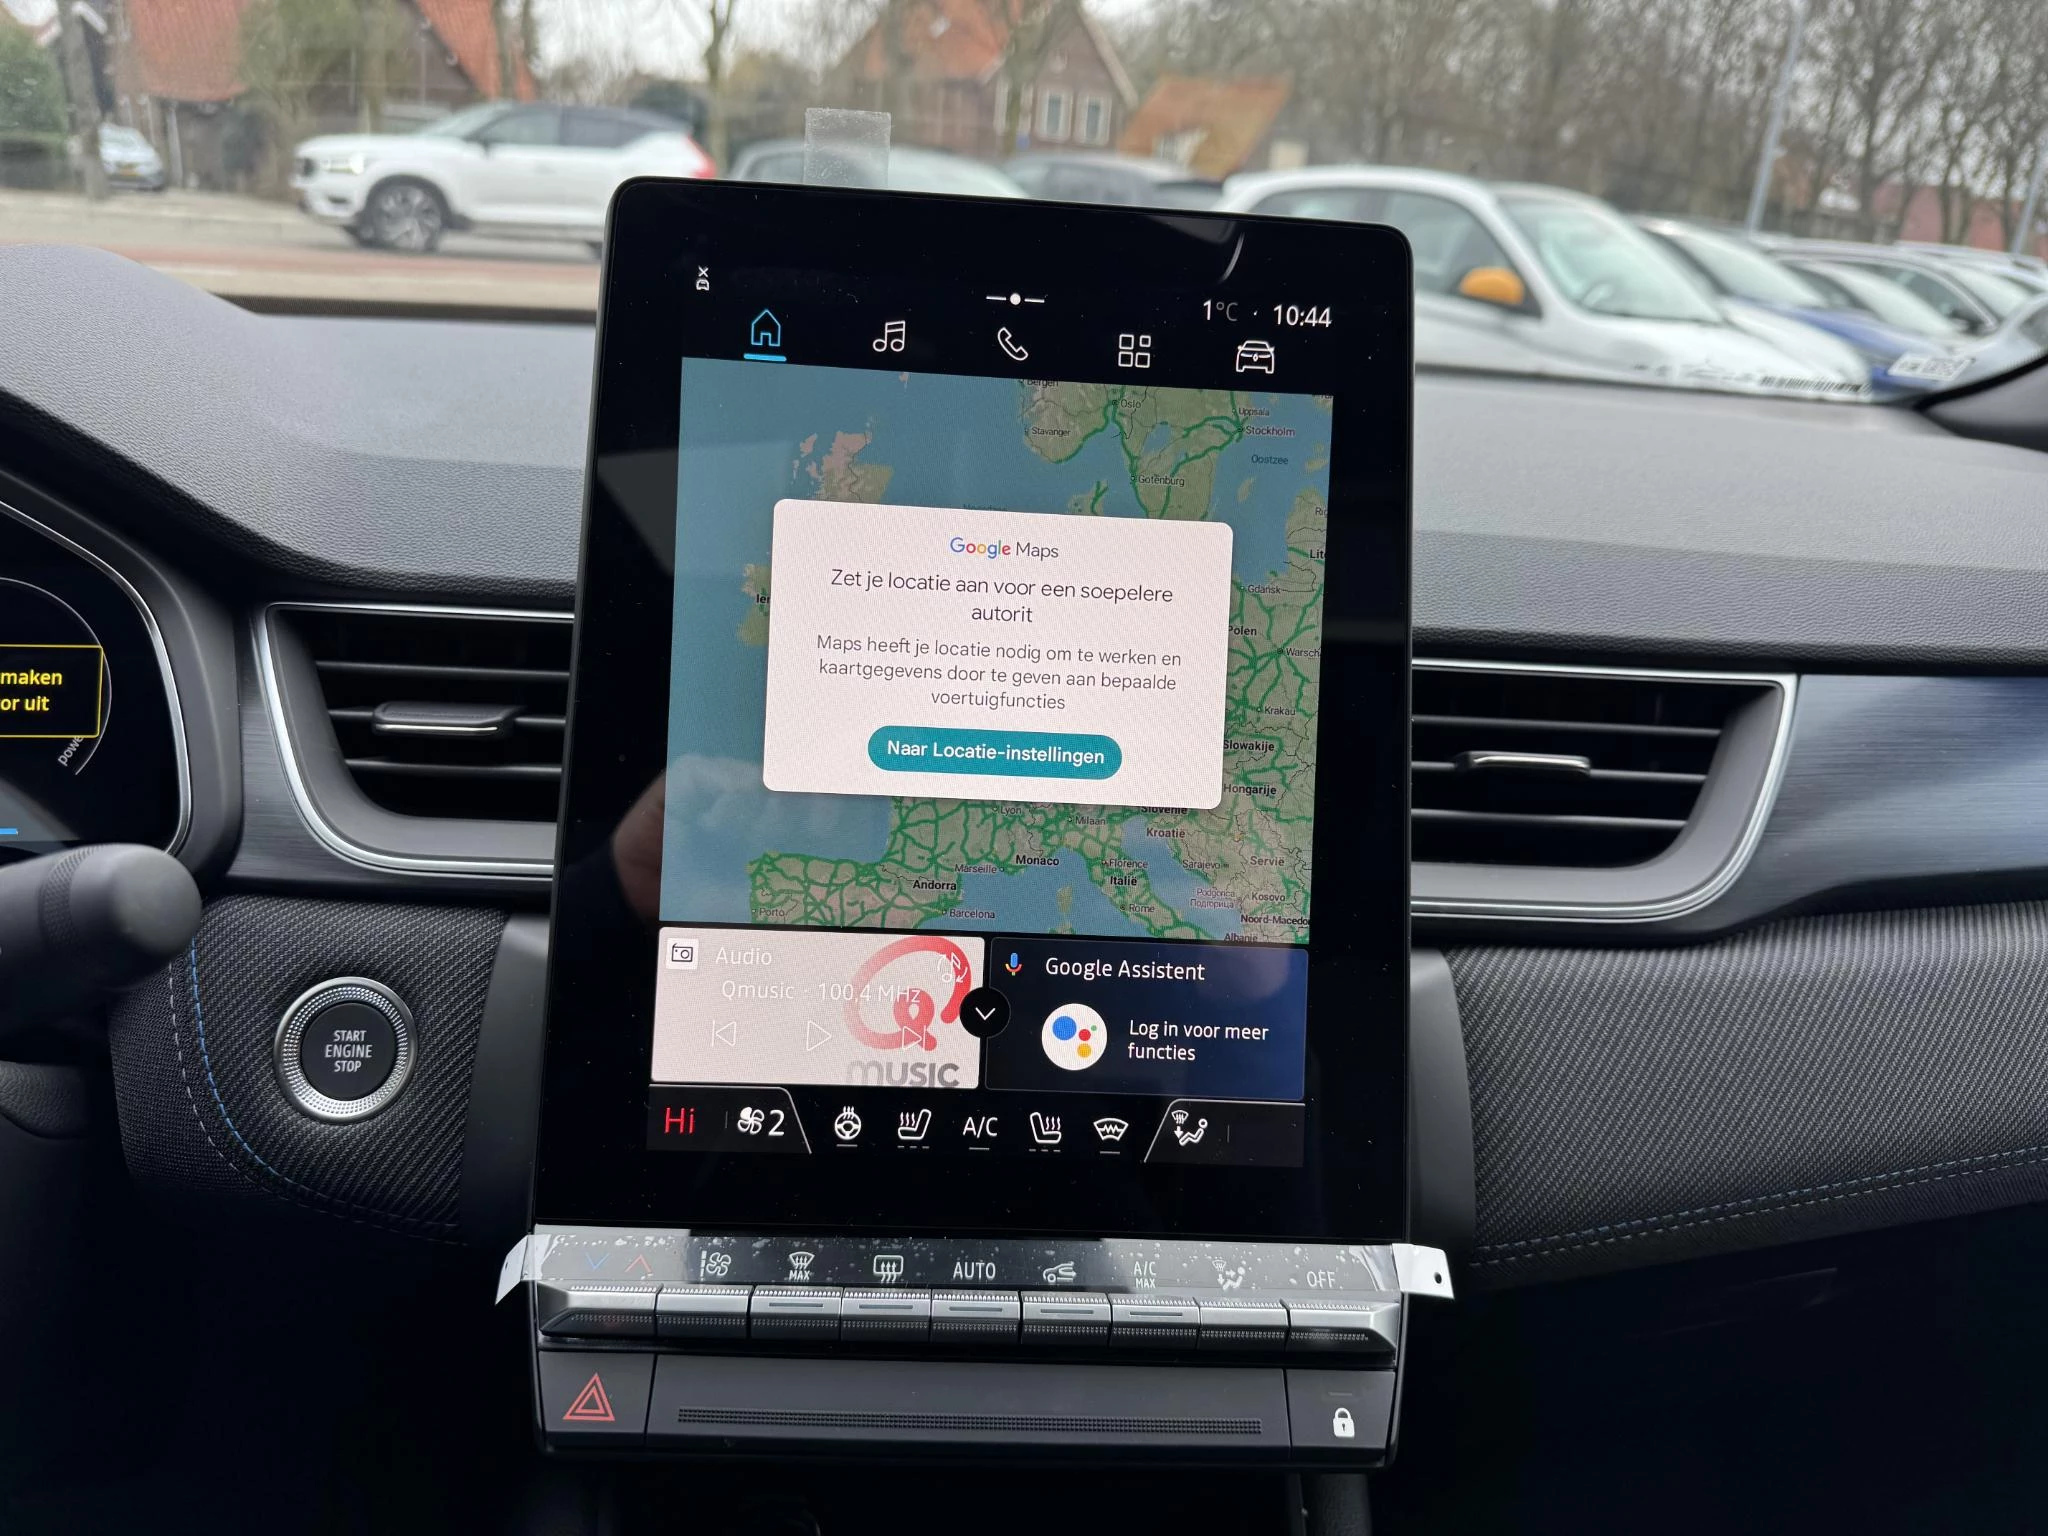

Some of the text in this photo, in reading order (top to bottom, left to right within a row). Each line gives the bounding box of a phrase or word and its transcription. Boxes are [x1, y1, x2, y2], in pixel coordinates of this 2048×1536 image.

[1273, 304, 1333, 328] 10:44
[1120, 399, 1142, 410] Oslo
[1238, 407, 1270, 418] Uppsala
[1031, 427, 1071, 439] Stavanger
[1246, 426, 1296, 437] Stockholm
[1251, 454, 1289, 465] Oostzee
[950, 537, 1059, 561] Google Maps
[831, 569, 1173, 604] Zet je locatie aan voor een soepelere
[971, 606, 1033, 623] autorit
[817, 635, 1181, 666] Maps heeft je locatie nodig om te werken en
[1286, 648, 1321, 658] Warsch
[0, 669, 63, 685] maken
[819, 658, 1176, 691] kaartgegevens door te geven aan bepaalde
[25, 696, 50, 711] uit
[931, 691, 1066, 710] voertuigfuncties
[1264, 706, 1296, 716] Krakau
[57, 736, 84, 766] powe
[1223, 740, 1275, 753] Slowakije
[887, 740, 1105, 767] Naar Locatie-instellingen
[1223, 784, 1277, 796] Hongarije
[1000, 806, 1022, 816] Lyon
[1075, 816, 1106, 825] Milaan
[1015, 855, 1060, 866] Monaco
[1109, 859, 1148, 868] Florence
[1182, 860, 1221, 870] Sarajevo
[954, 863, 997, 874] Marseille
[912, 880, 957, 891] Andorra
[1251, 892, 1286, 902] Kosovo
[759, 908, 785, 917] Porto
[949, 909, 996, 919] Barcelona
[1129, 904, 1155, 913] Rome
[1241, 914, 1310, 926] Noord-Macedo
[715, 947, 773, 966] Audio
[1045, 958, 1206, 981] Google Assistent
[721, 980, 795, 1000] Qmusic
[878, 985, 921, 1003] MHz
[333, 1030, 367, 1042] START
[1129, 1019, 1270, 1041] Log in voor meer
[324, 1044, 373, 1058] ENGINE
[1128, 1043, 1196, 1061] functies
[333, 1060, 362, 1073] STOP
[664, 1107, 696, 1134] Hi
[767, 1109, 786, 1137] 2
[963, 1116, 998, 1139] A/C
[952, 1261, 997, 1280] AUTO
[1133, 1260, 1157, 1276] A/C
[788, 1269, 811, 1281] MAX
[1307, 1270, 1337, 1289] OFF
[1135, 1278, 1156, 1289] MAX
